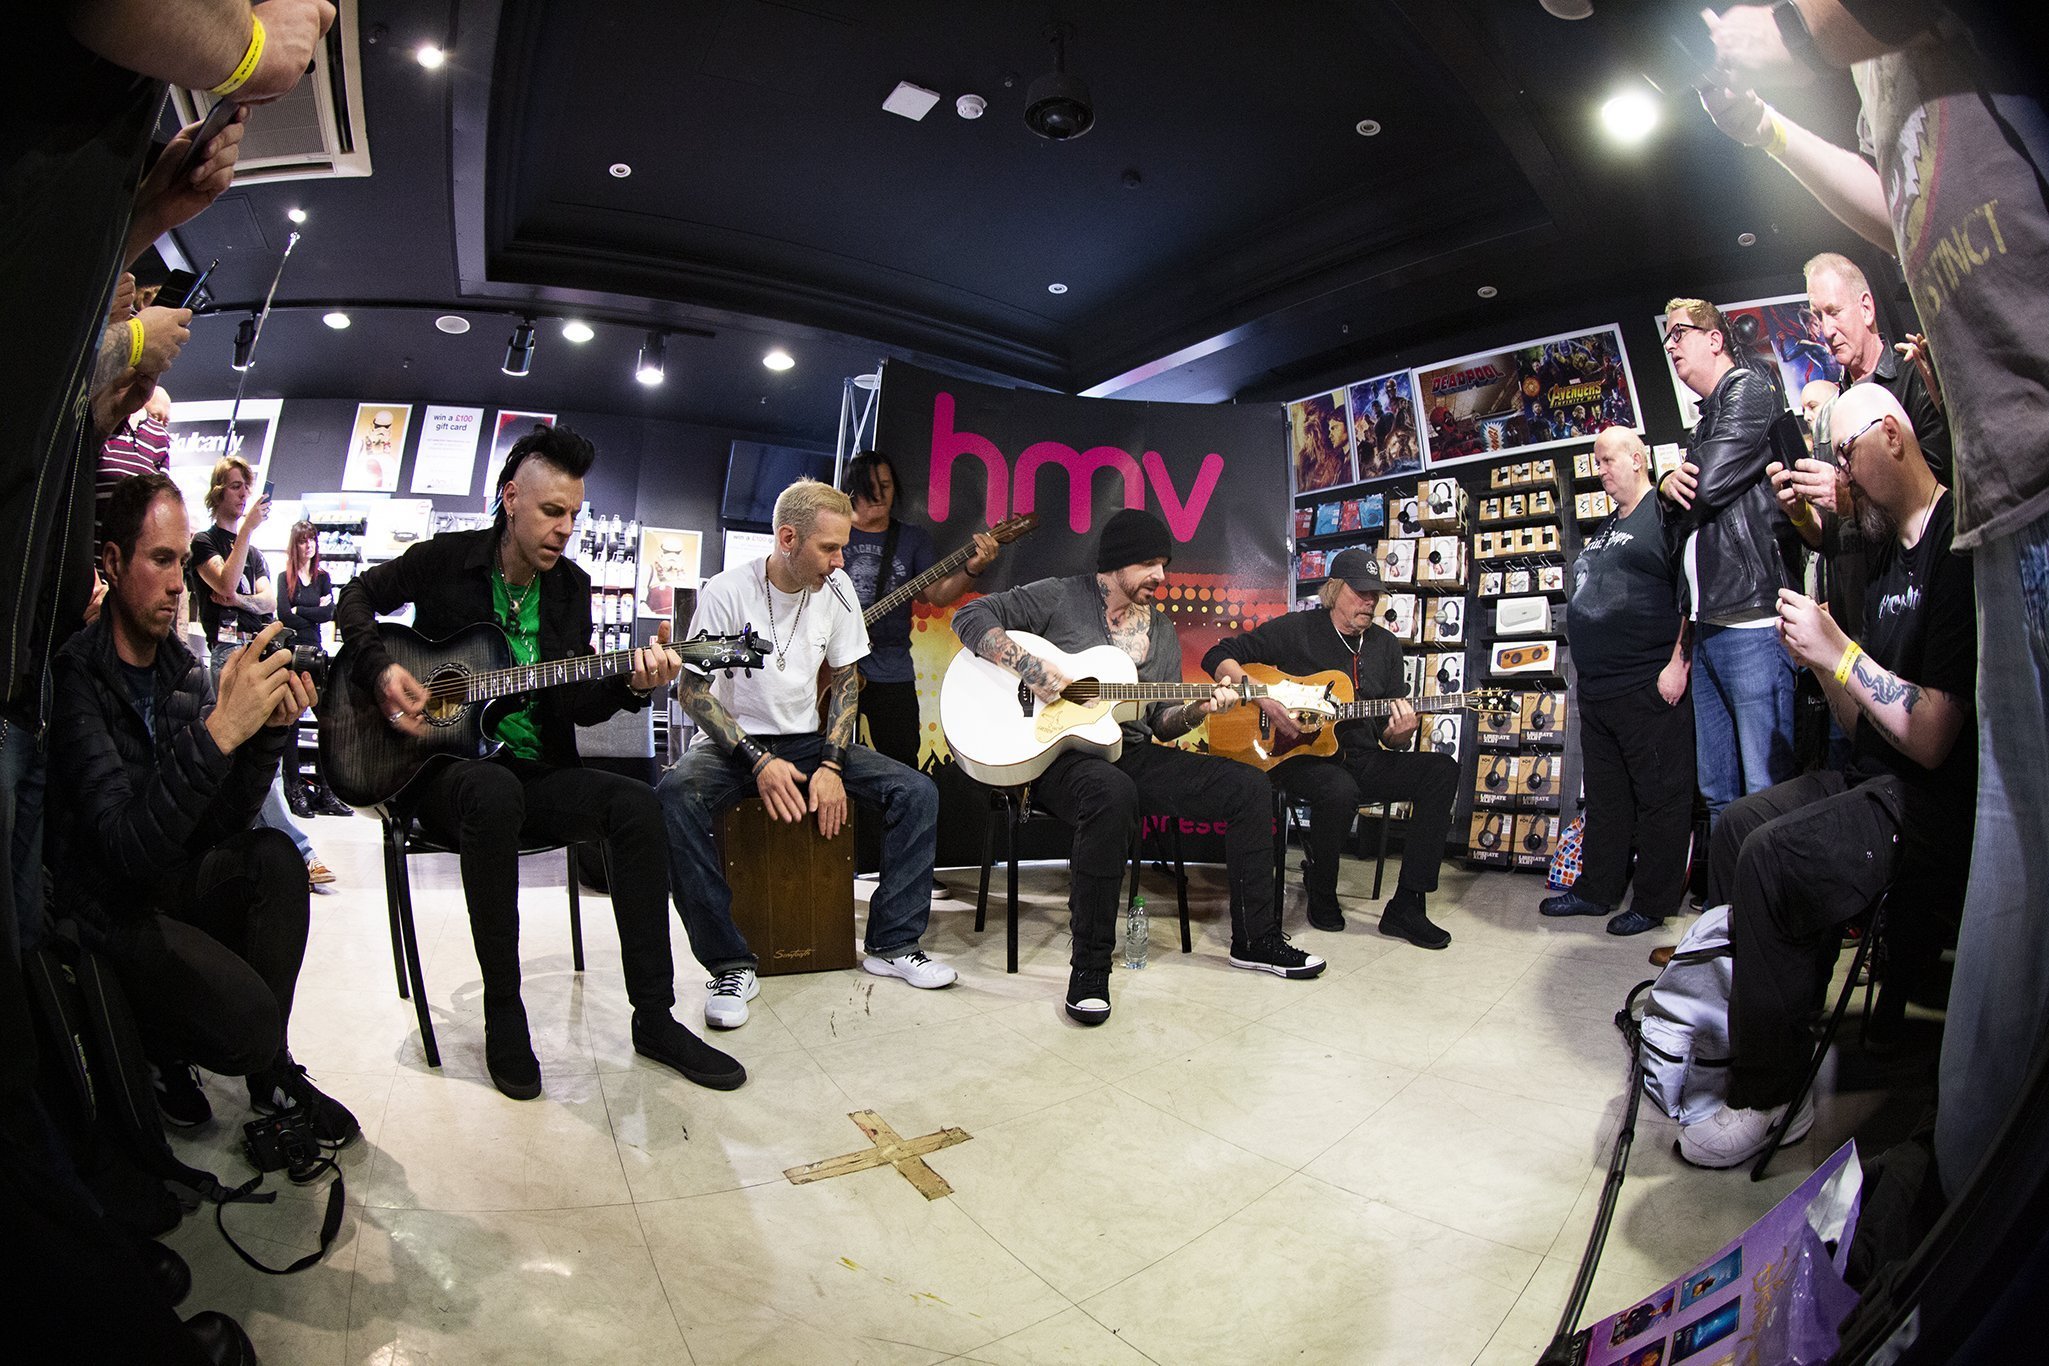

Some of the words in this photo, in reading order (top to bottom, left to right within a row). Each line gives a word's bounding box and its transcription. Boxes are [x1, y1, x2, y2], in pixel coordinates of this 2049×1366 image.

[1432, 364, 1506, 394] DEADPOOL
[433, 413, 446, 421] win
[455, 414, 473, 423] £100
[436, 422, 448, 432] gift
[450, 423, 467, 432] card
[928, 391, 1224, 542] hmv
